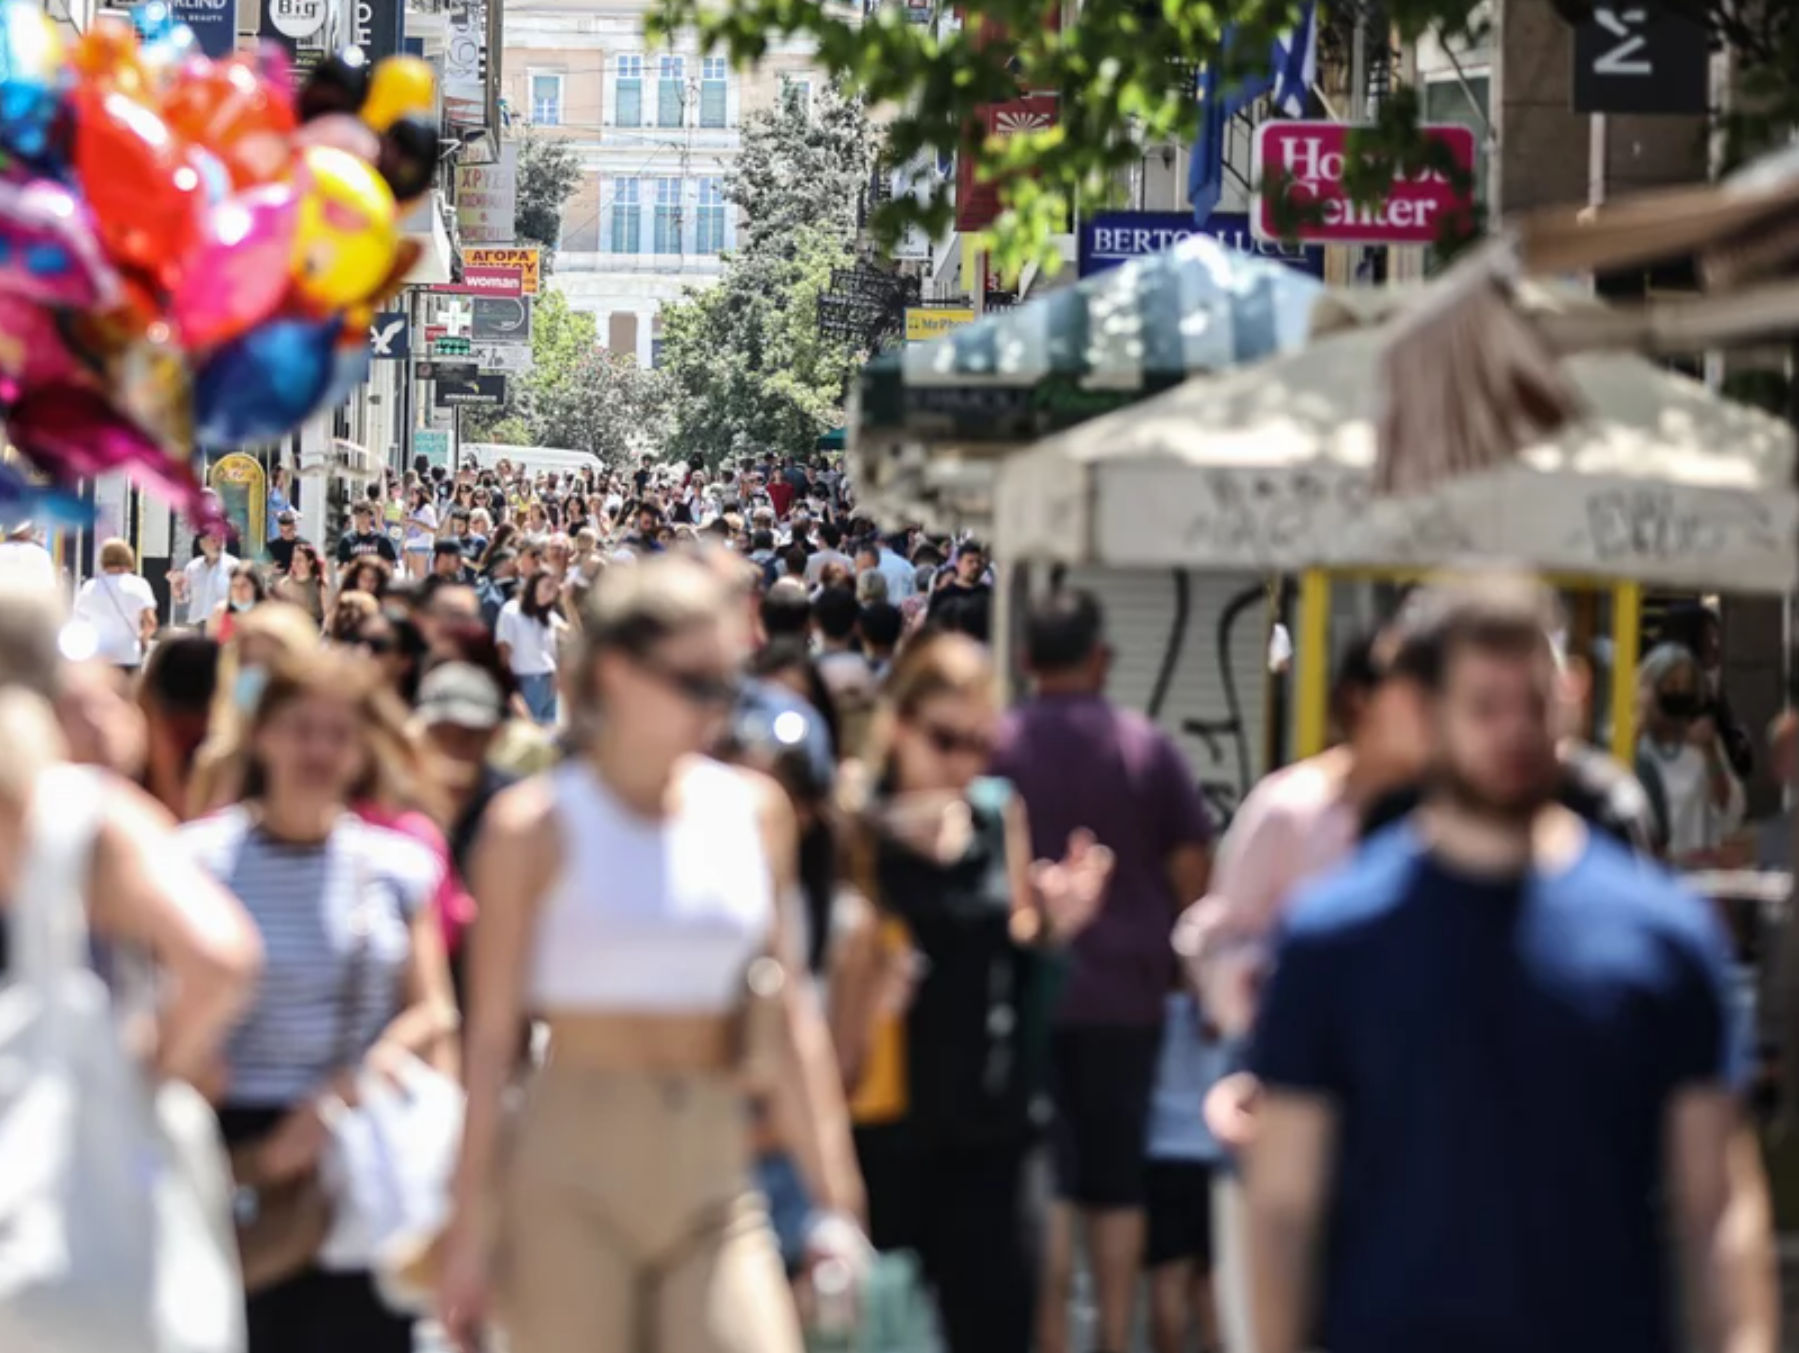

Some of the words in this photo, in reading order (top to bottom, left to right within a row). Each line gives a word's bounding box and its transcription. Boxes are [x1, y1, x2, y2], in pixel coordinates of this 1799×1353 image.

[279, 0, 319, 18] Big
[188, 14, 224, 22] BEAUTY
[472, 250, 530, 261] ΑΓΟΡΑ
[465, 276, 520, 289] woman
